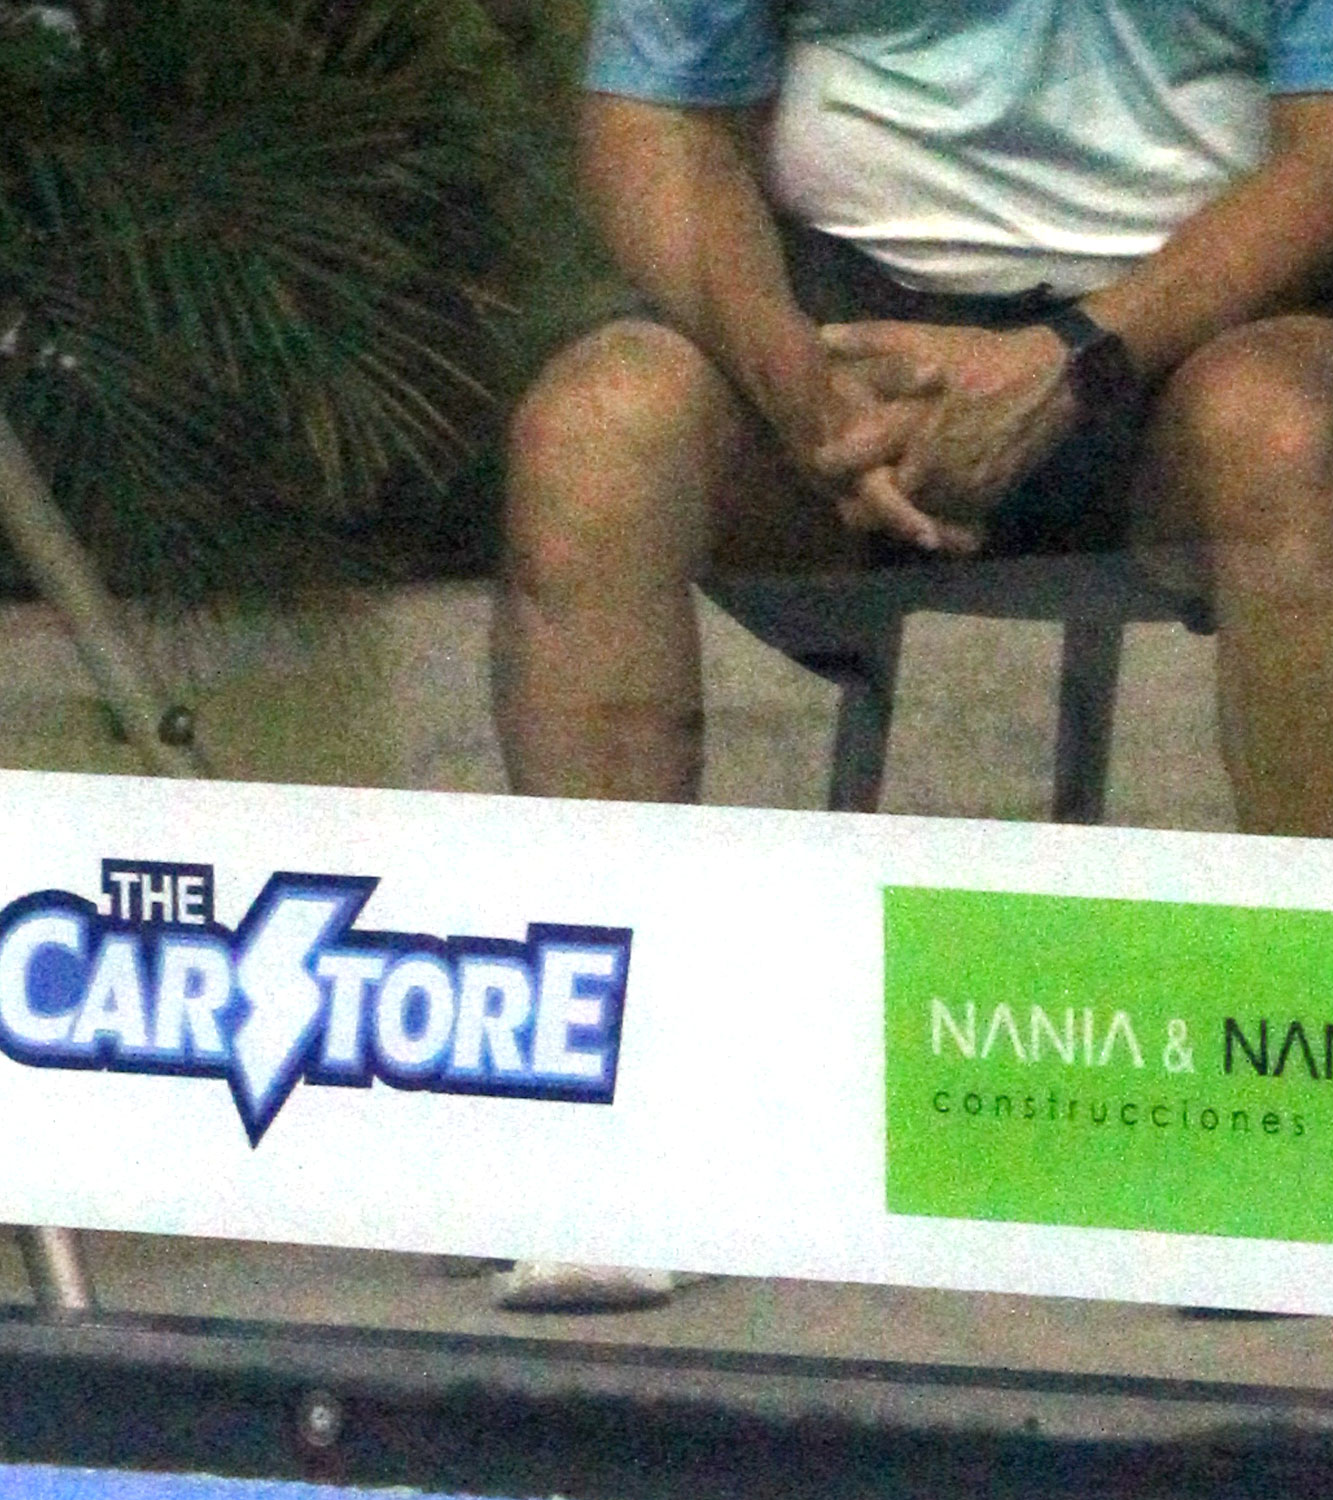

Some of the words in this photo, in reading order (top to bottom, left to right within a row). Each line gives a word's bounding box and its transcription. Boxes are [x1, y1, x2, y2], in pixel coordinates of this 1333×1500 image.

[108, 870, 211, 926] THE
[931, 998, 1145, 1068] NANIA
[1162, 1018, 1195, 1073] &
[932, 1091, 1306, 1136] construcciones
